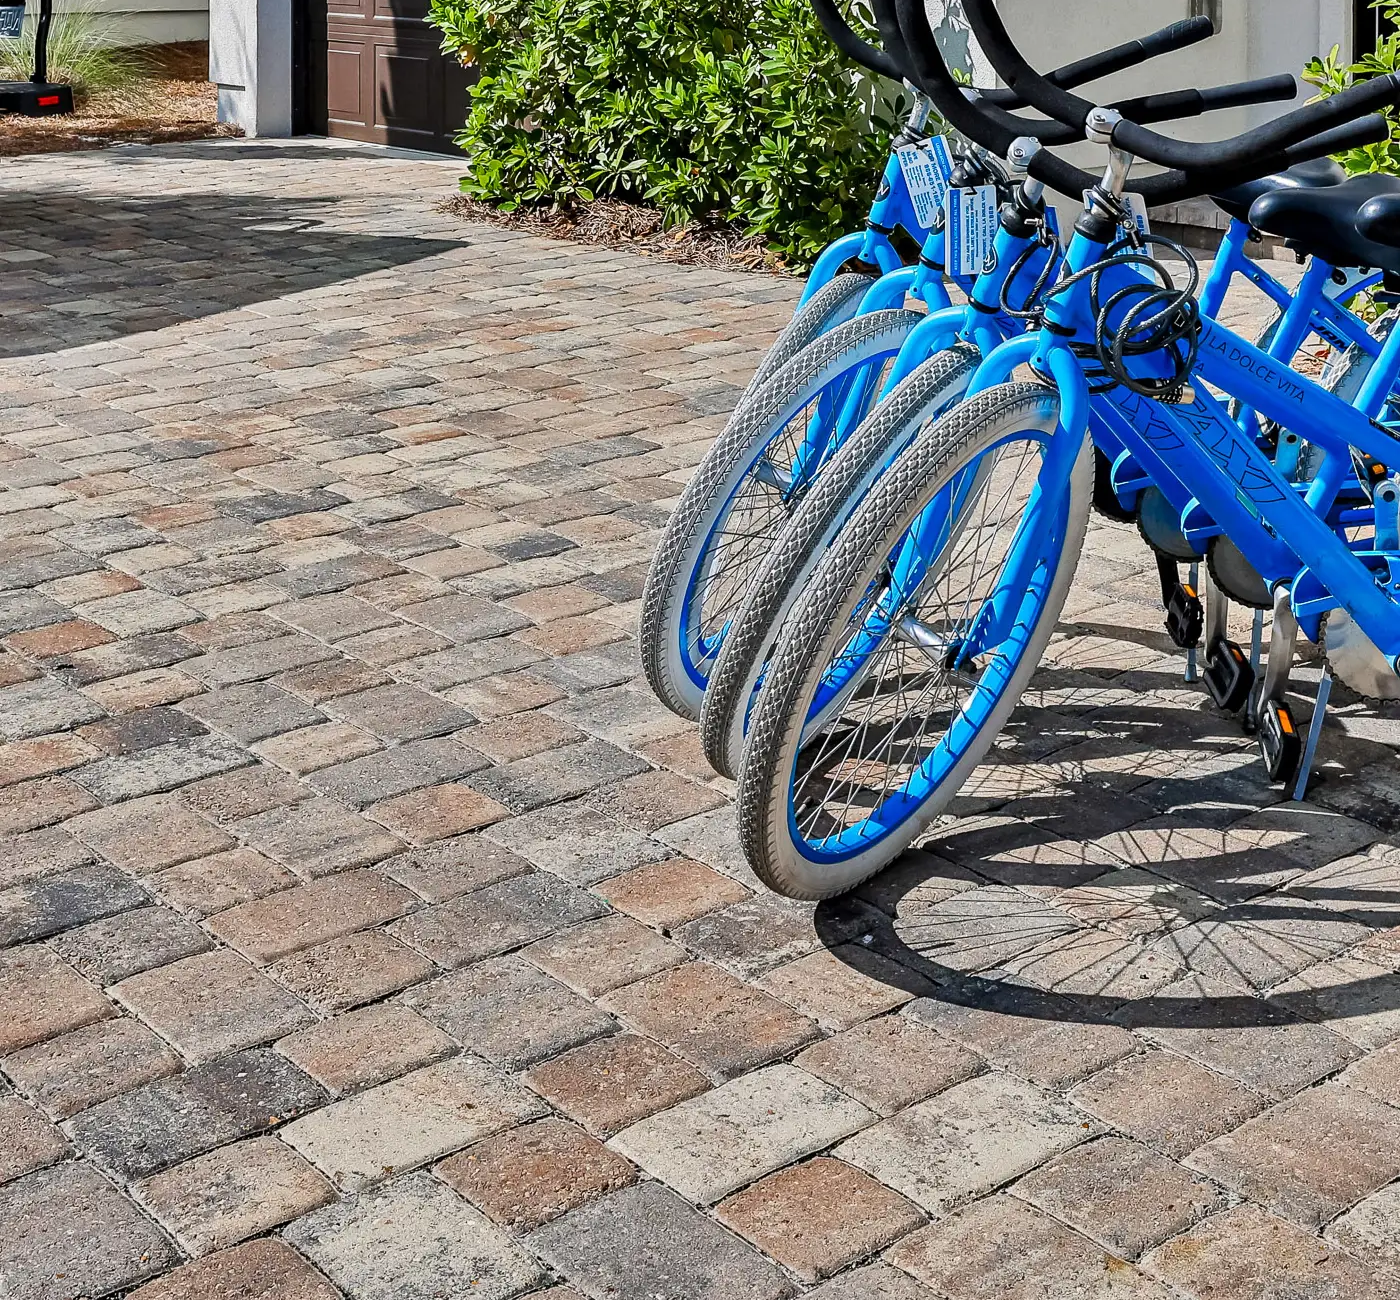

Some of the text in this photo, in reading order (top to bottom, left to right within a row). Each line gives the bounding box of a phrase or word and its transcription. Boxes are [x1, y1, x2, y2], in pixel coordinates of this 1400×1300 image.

[1209, 336, 1227, 355] LA
[1229, 348, 1277, 384] DOLCE
[1278, 378, 1305, 404] VITA
